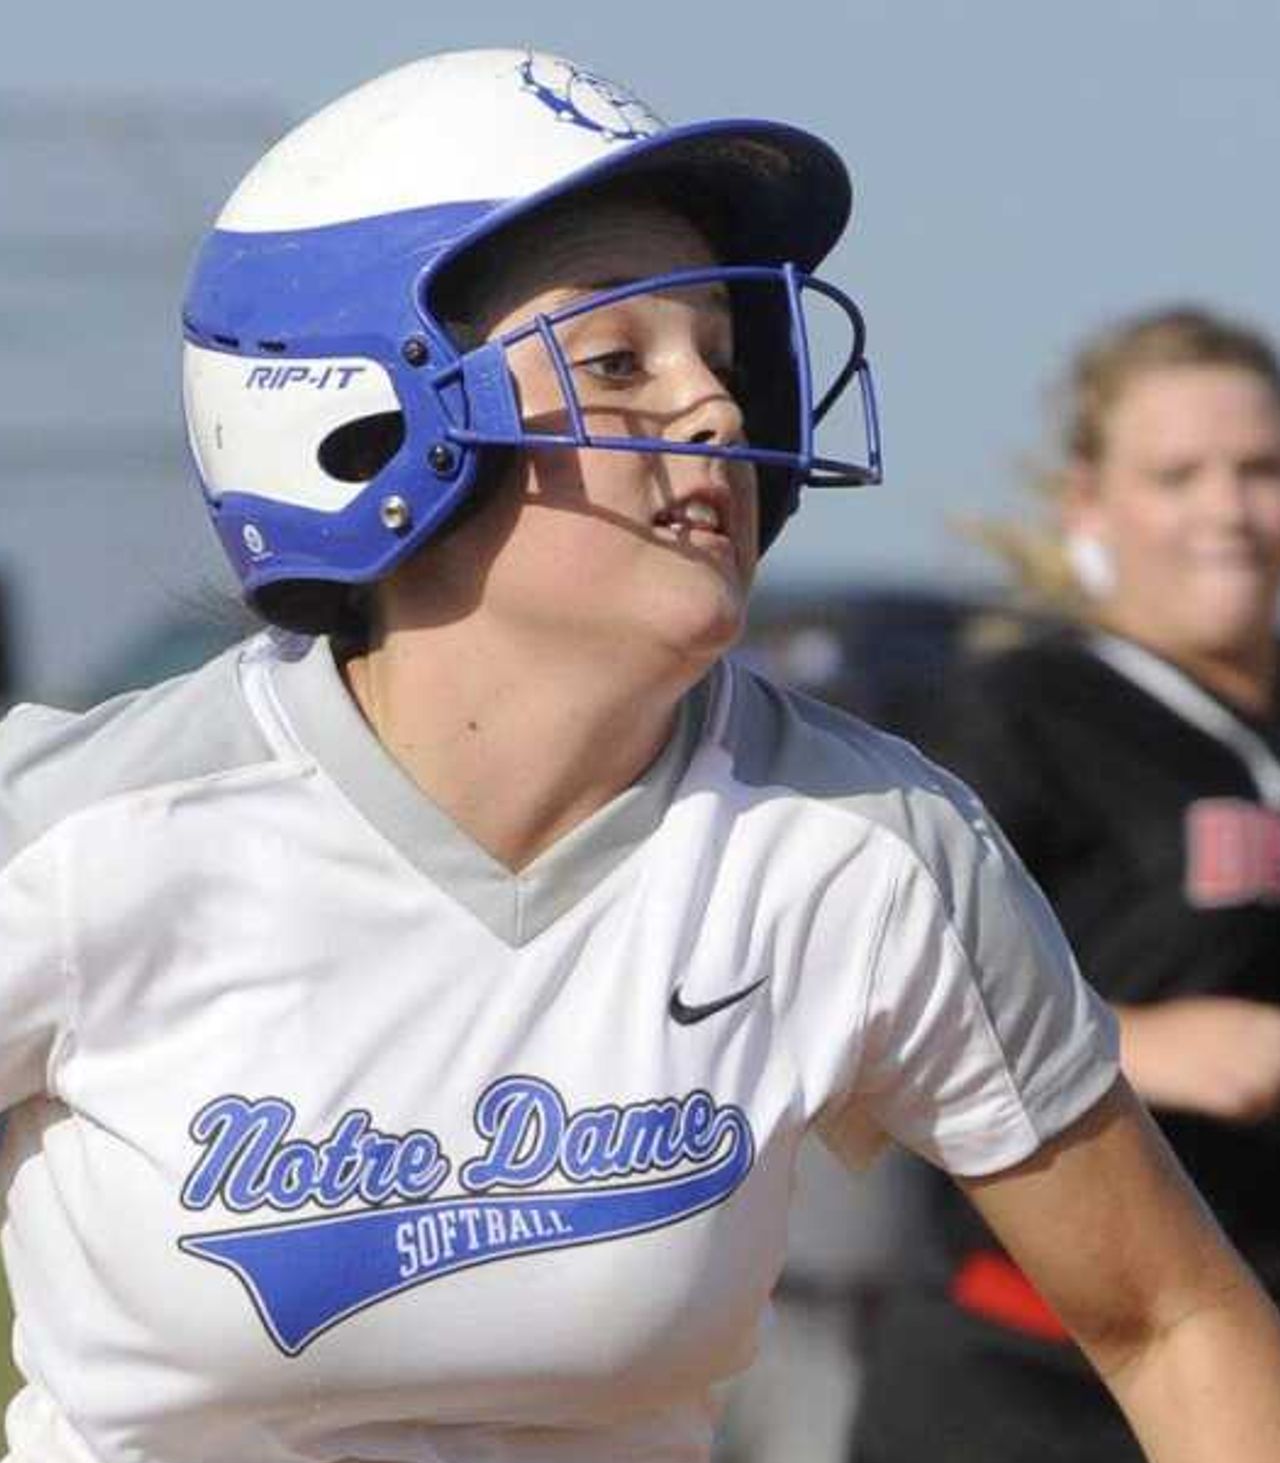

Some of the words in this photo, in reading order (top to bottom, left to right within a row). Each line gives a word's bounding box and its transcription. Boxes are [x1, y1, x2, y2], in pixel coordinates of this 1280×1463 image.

[246, 366, 366, 390] RIP-IT
[181, 1095, 448, 1210] Notre
[459, 1075, 726, 1193] Dame
[395, 1208, 573, 1277] SOFTBALL
